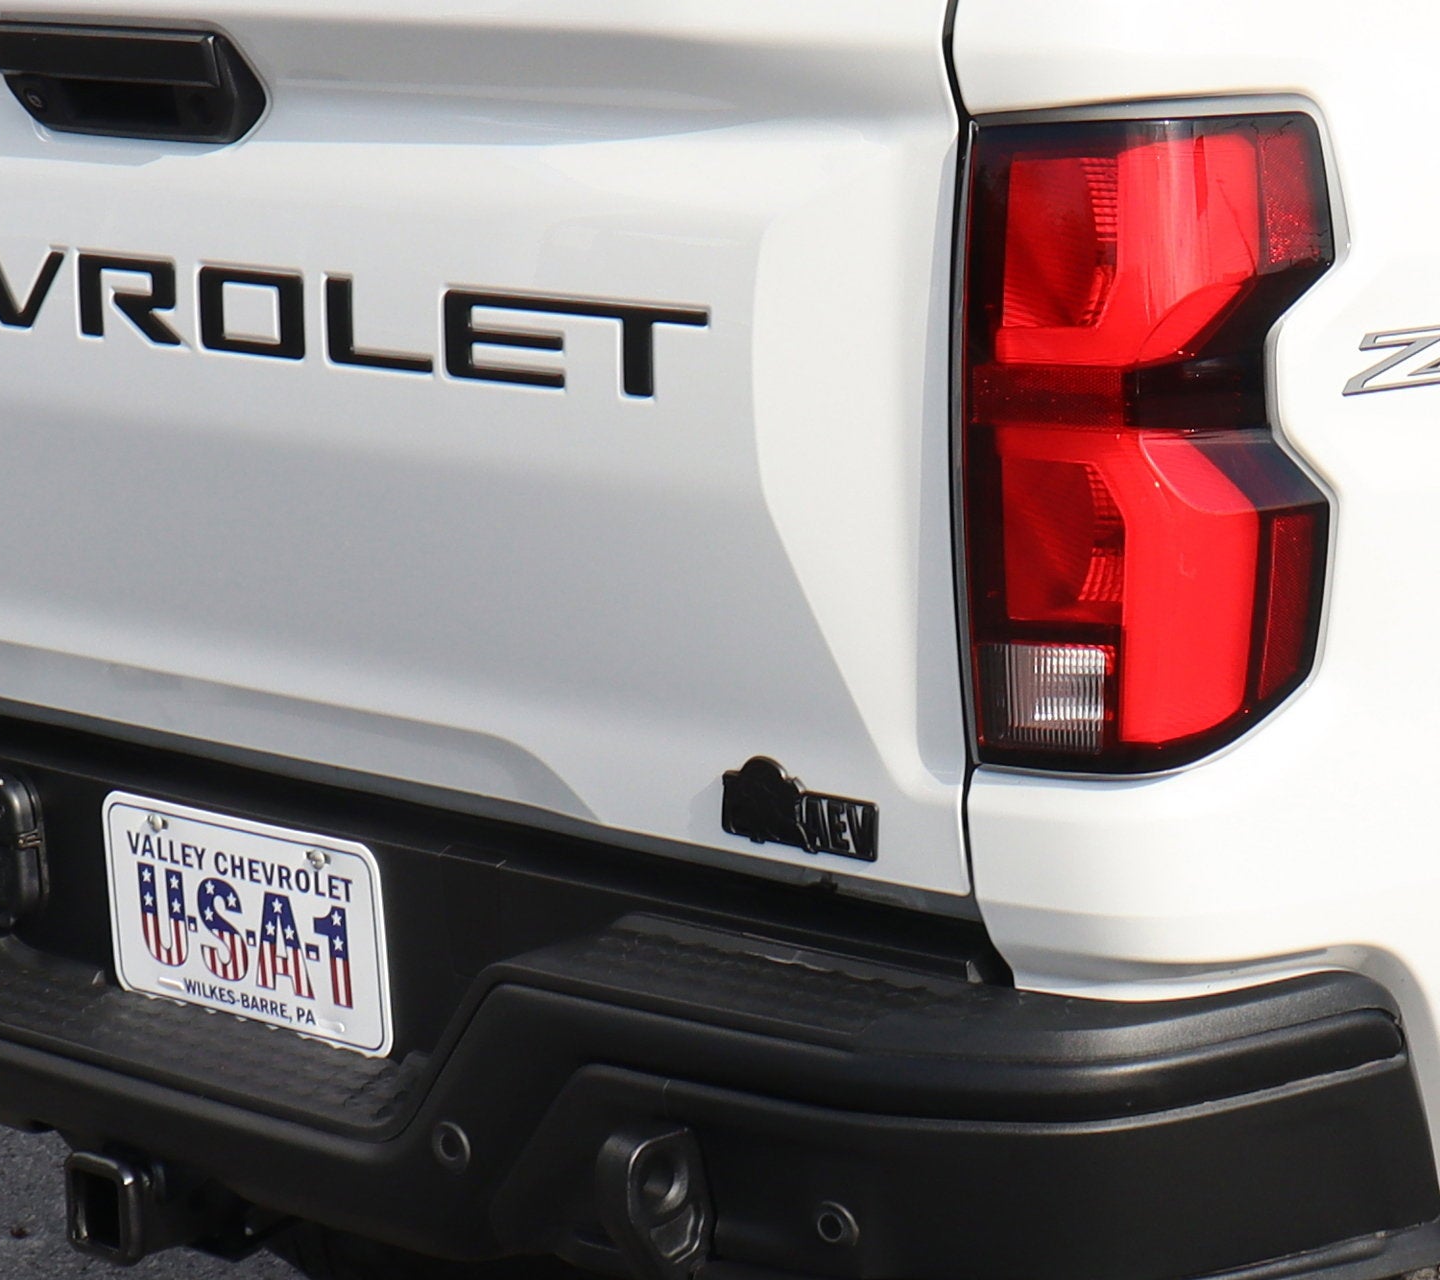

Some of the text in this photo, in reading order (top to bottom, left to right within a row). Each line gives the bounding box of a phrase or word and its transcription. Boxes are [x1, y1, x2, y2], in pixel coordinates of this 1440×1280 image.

[800, 795, 875, 859] AEV
[126, 829, 353, 903] VALLEY CHEVROLET
[182, 977, 317, 1026] WILKES-BARRE, PA
